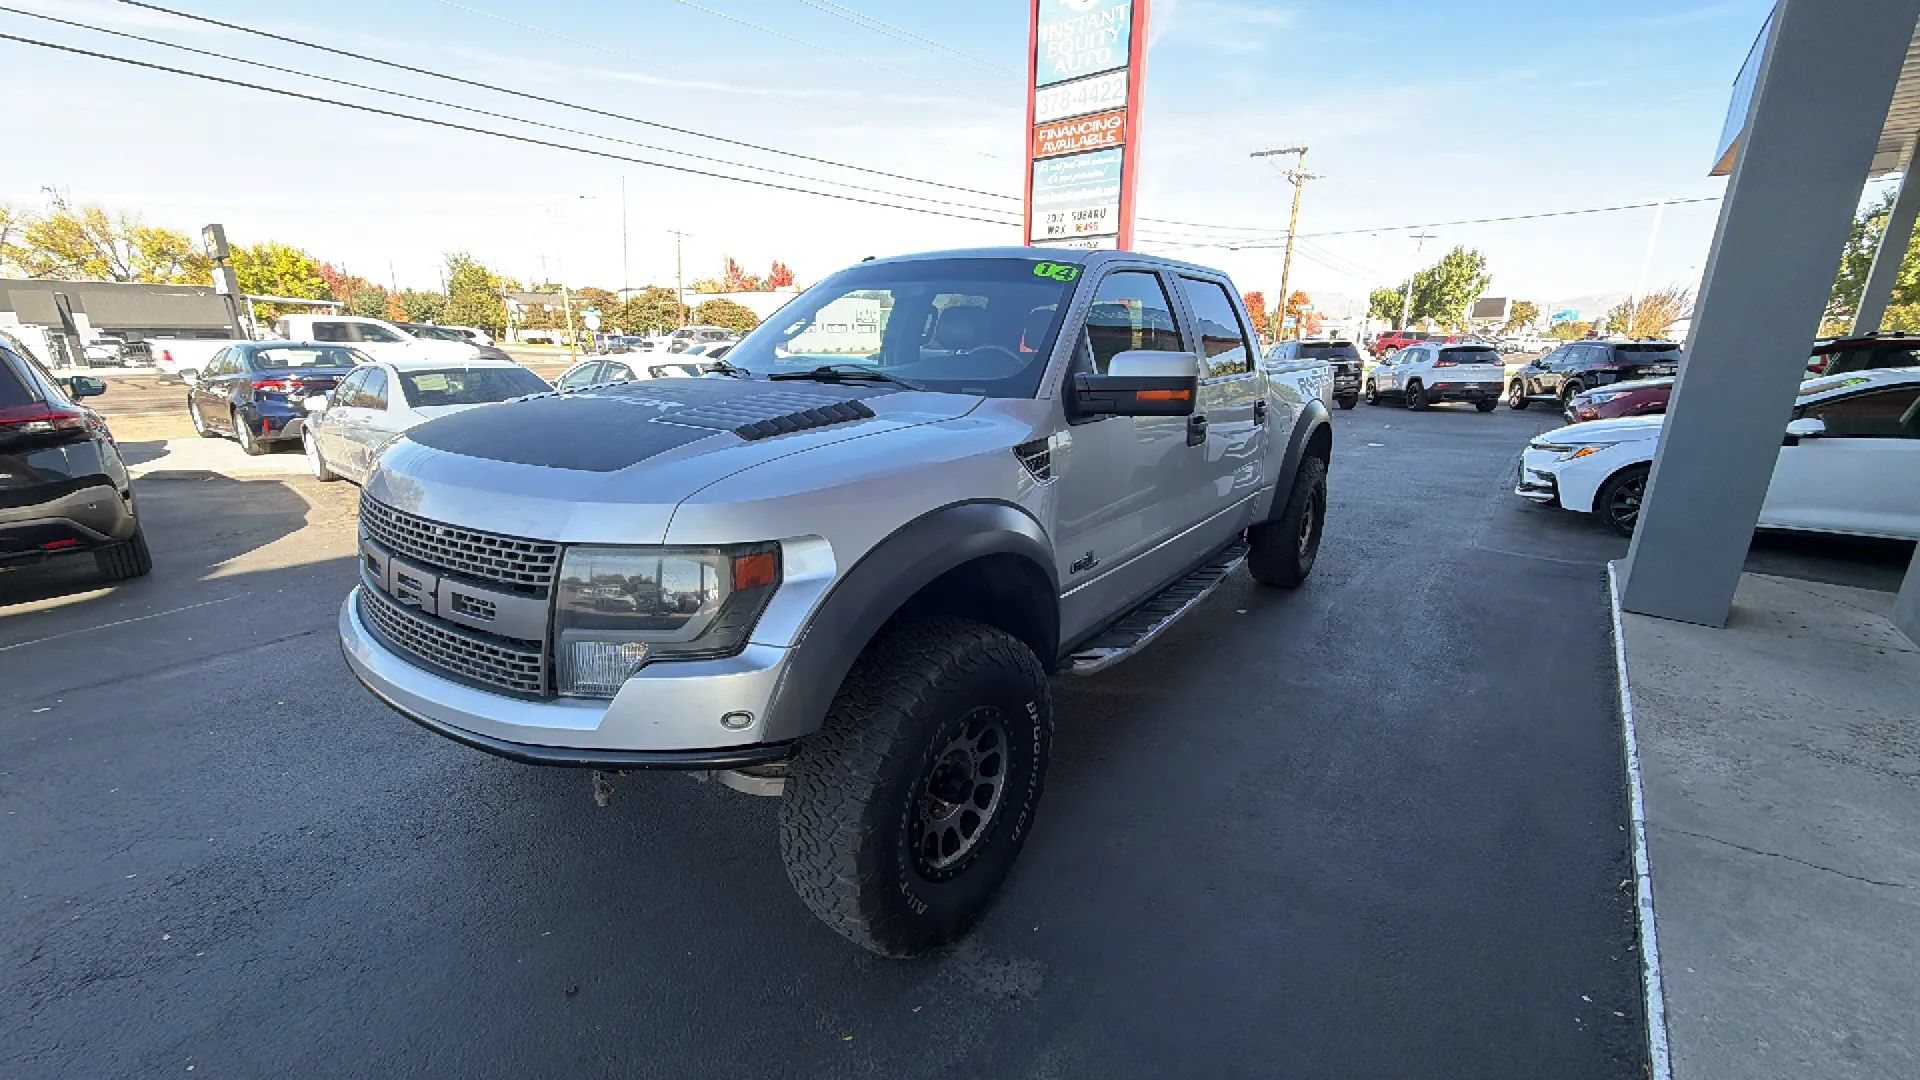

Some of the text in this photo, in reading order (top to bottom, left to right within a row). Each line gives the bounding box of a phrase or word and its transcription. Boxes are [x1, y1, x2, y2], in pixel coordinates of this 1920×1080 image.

[1041, 3, 1129, 42] INSTANT
[1046, 24, 1123, 58] EQUITY
[1054, 48, 1111, 74] AUTO
[1038, 115, 1122, 141] FINANCING
[1041, 130, 1117, 152] AVAILABLE
[1071, 208, 1107, 221] SUBARU
[1047, 225, 1066, 235] WRX
